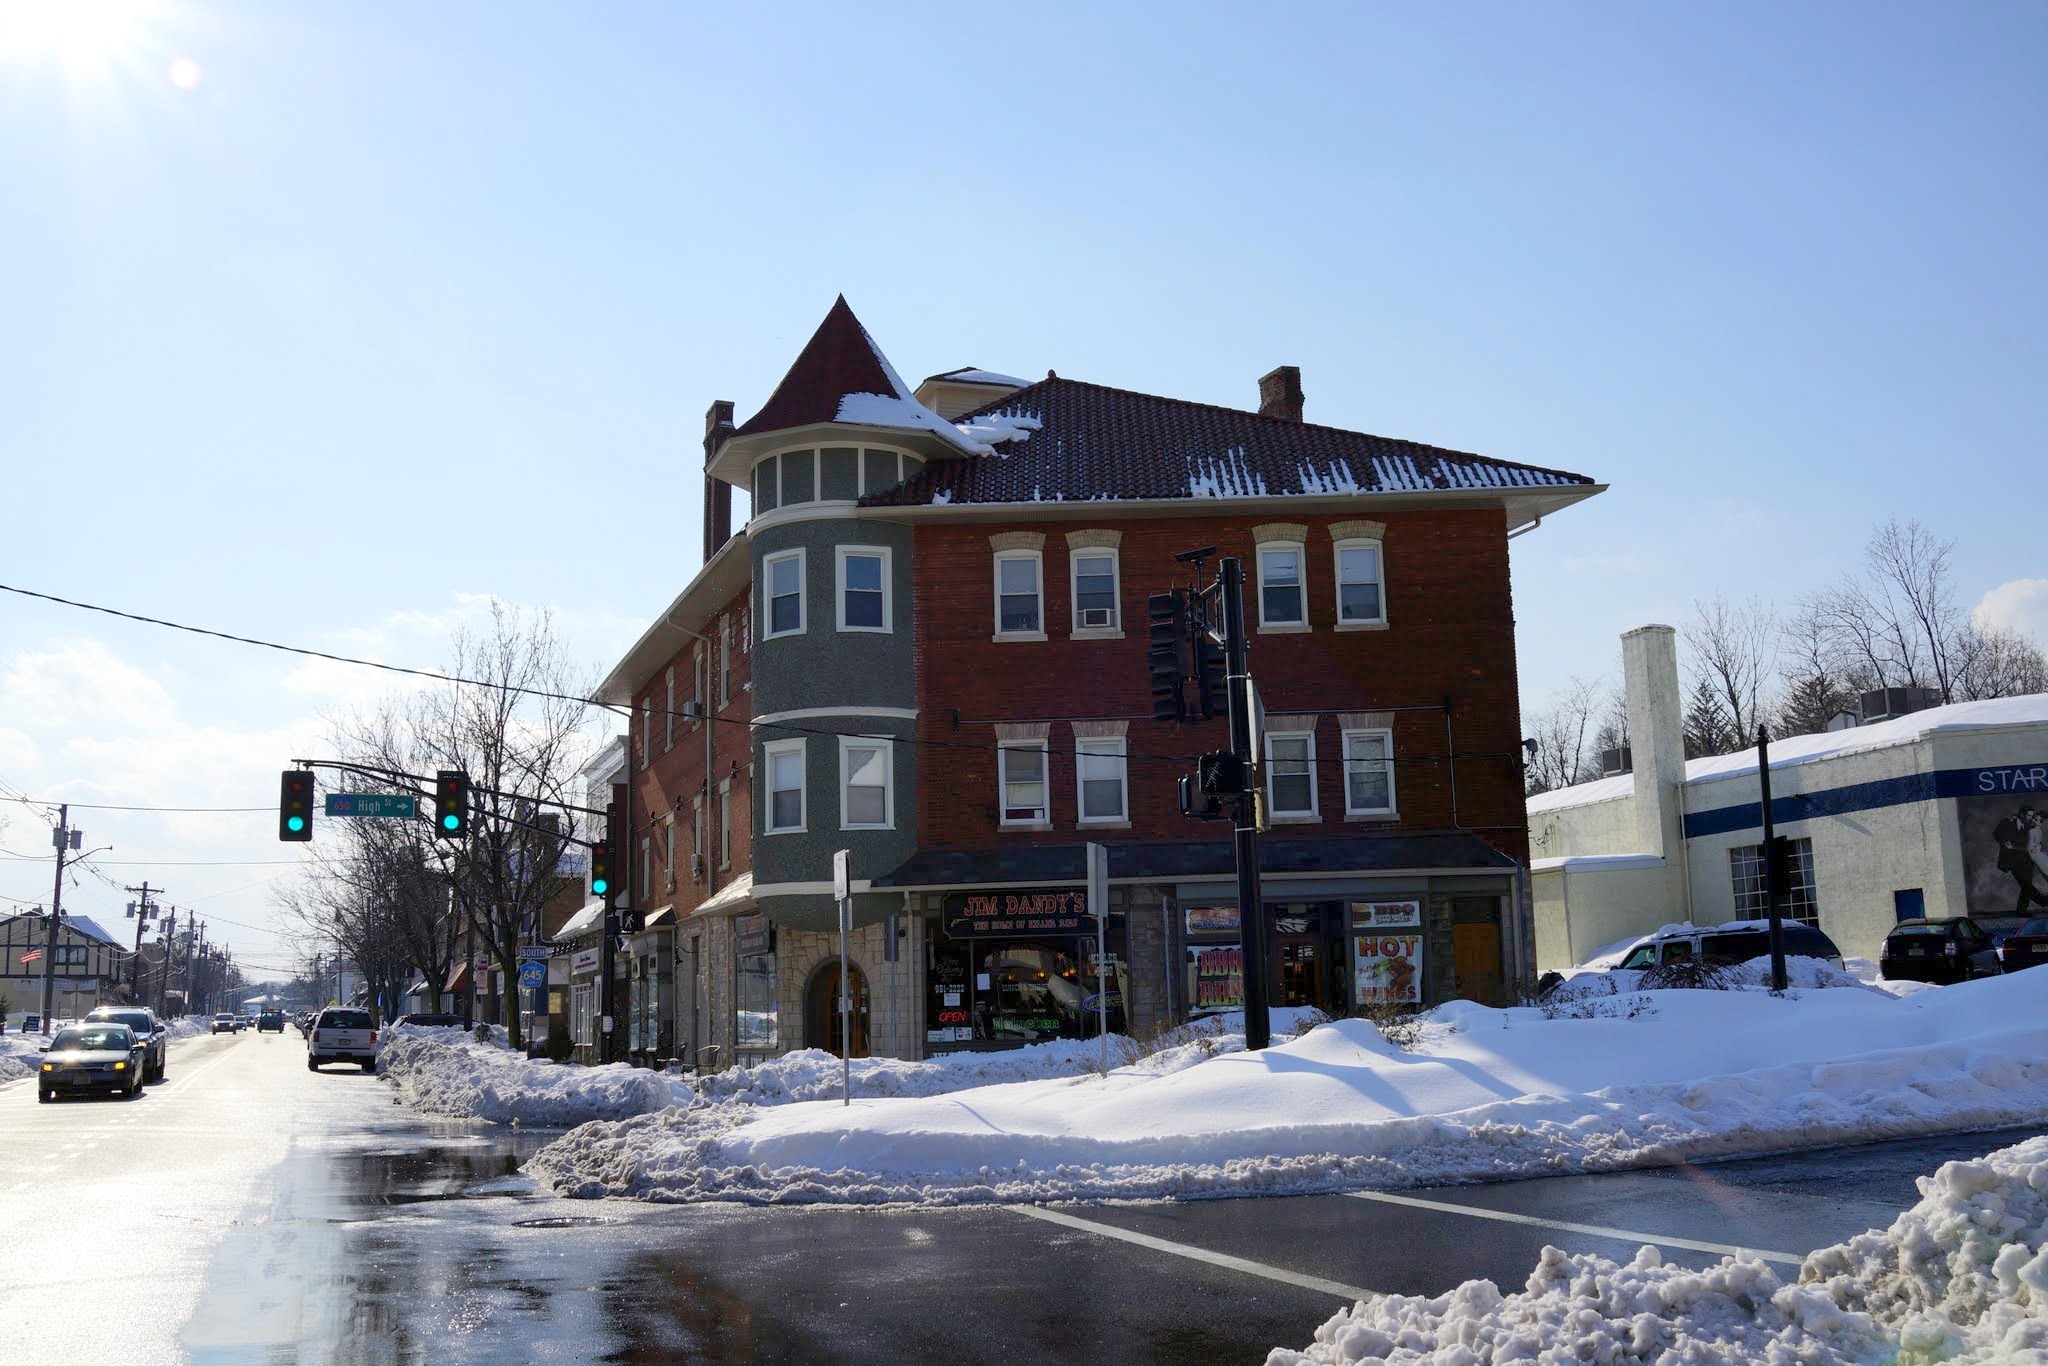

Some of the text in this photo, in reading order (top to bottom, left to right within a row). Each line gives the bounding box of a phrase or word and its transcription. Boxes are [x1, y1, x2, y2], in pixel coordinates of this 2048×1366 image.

[1978, 768, 2048, 792] STAR
[358, 799, 381, 815] High
[384, 799, 392, 807] St
[963, 896, 998, 916] JIM
[521, 948, 545, 957] SOUTH
[1359, 936, 1419, 957] HOT
[523, 970, 542, 980] 645
[1361, 986, 1417, 1000] WINGS
[938, 1010, 967, 1023] OPEN
[992, 1017, 1060, 1030] Heineken
